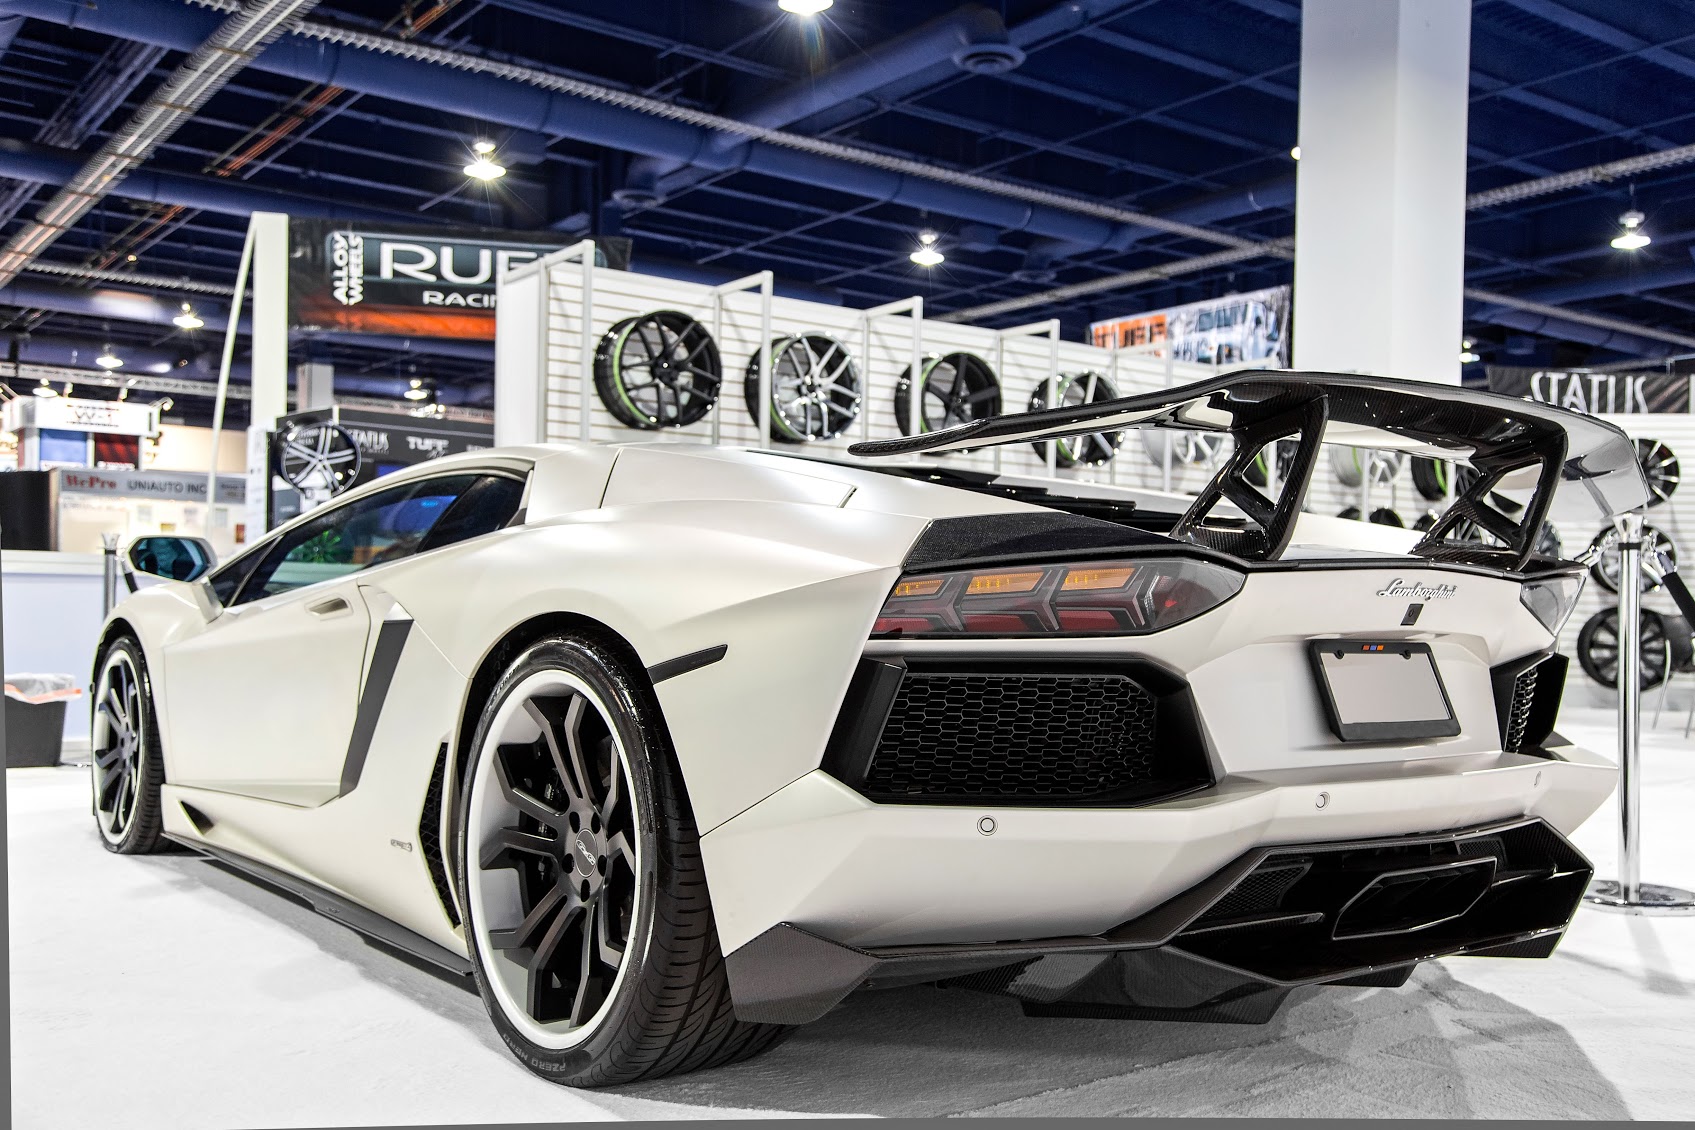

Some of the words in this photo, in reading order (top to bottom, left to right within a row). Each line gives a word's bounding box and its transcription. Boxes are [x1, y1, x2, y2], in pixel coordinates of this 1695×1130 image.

[333, 232, 348, 305] ALLOY
[348, 232, 363, 306] WHEELS
[380, 242, 583, 284] RUF
[127, 479, 184, 493] UNIAUTO
[1376, 578, 1457, 601] Lamborghini
